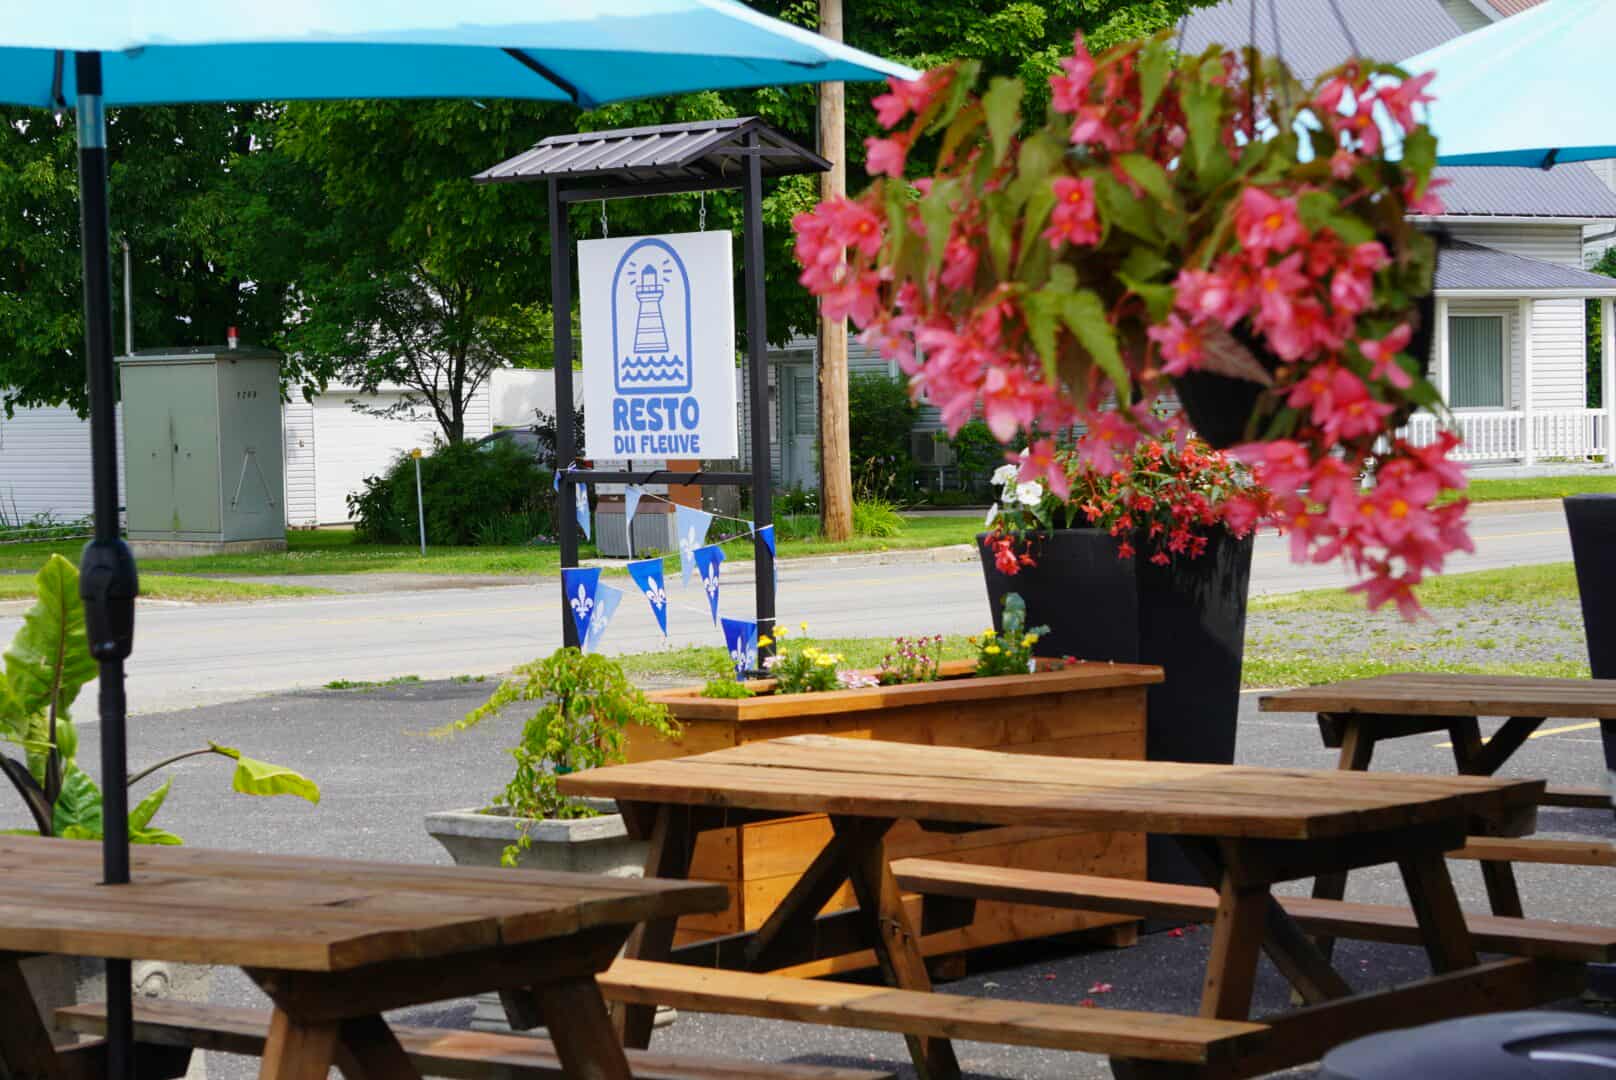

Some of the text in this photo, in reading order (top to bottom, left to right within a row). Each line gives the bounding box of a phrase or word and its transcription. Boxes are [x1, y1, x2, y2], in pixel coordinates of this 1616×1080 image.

[613, 396, 700, 432] RESTO
[613, 434, 700, 454] DU FLEUVE
